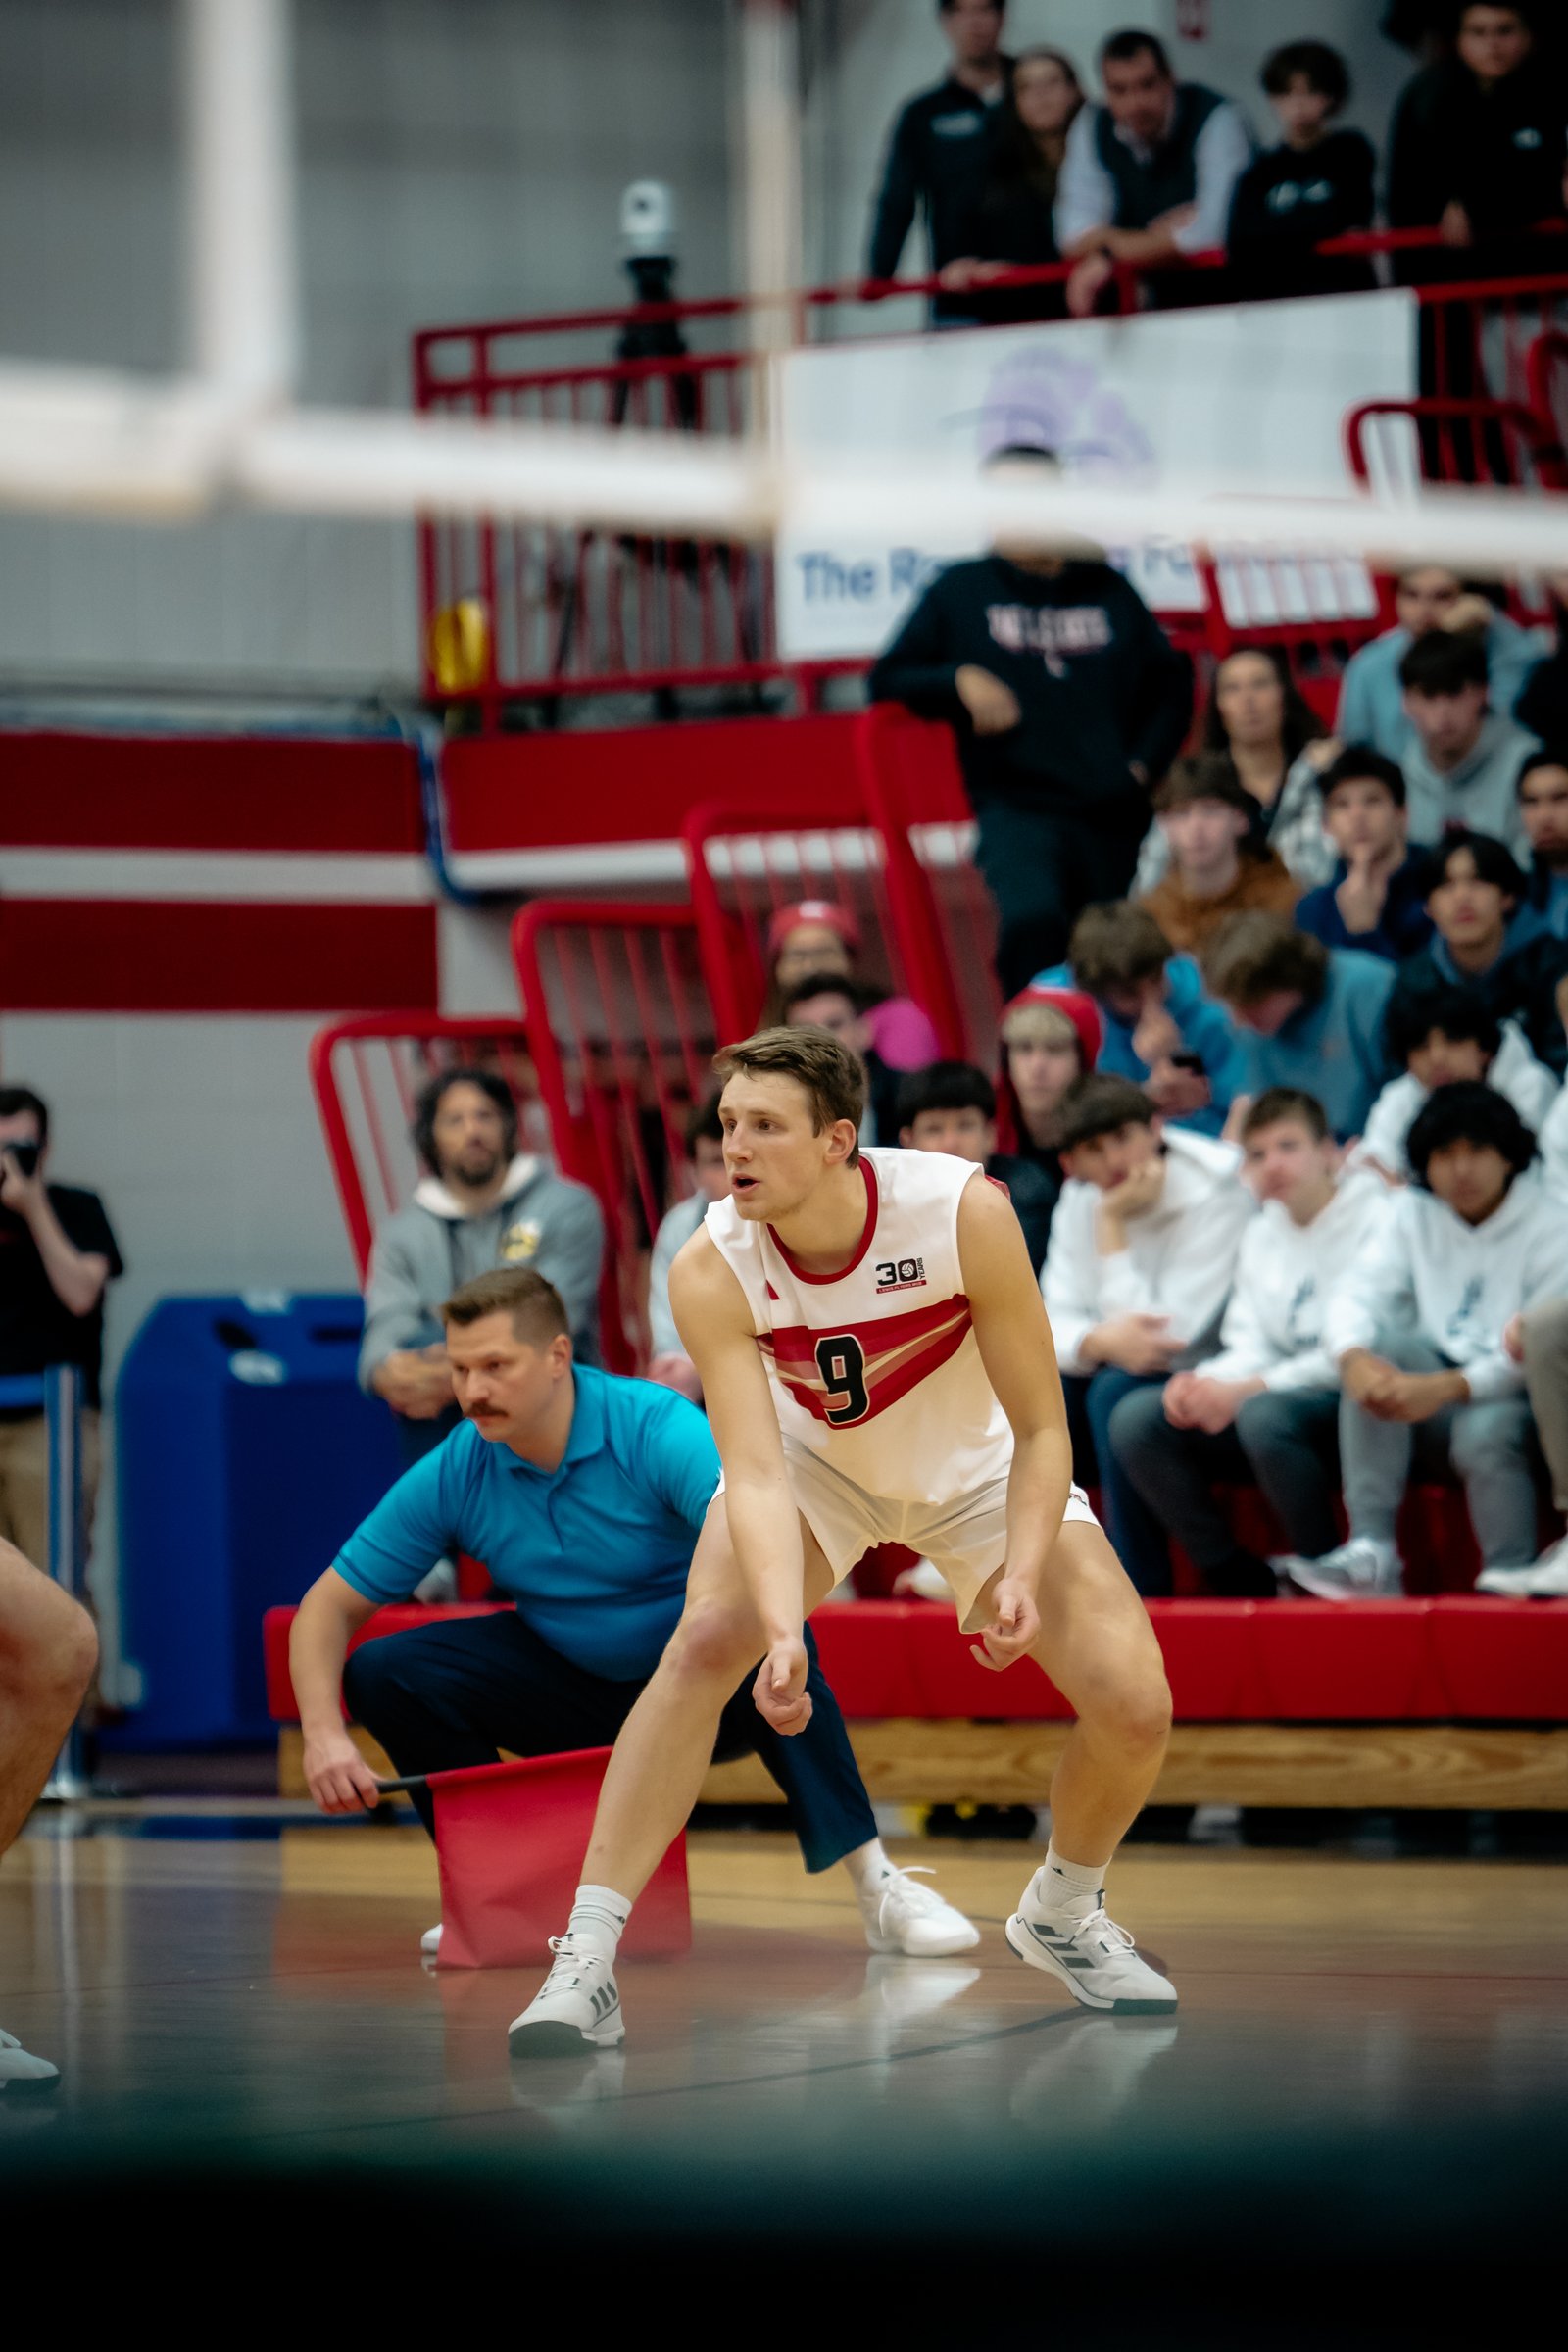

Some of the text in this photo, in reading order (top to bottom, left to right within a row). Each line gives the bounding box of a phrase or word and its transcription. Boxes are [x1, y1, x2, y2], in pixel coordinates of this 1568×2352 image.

[794, 550, 877, 604] The
[875, 1258, 919, 1286] 30
[916, 1257, 925, 1279] YEARS
[814, 1333, 871, 1425] 9
